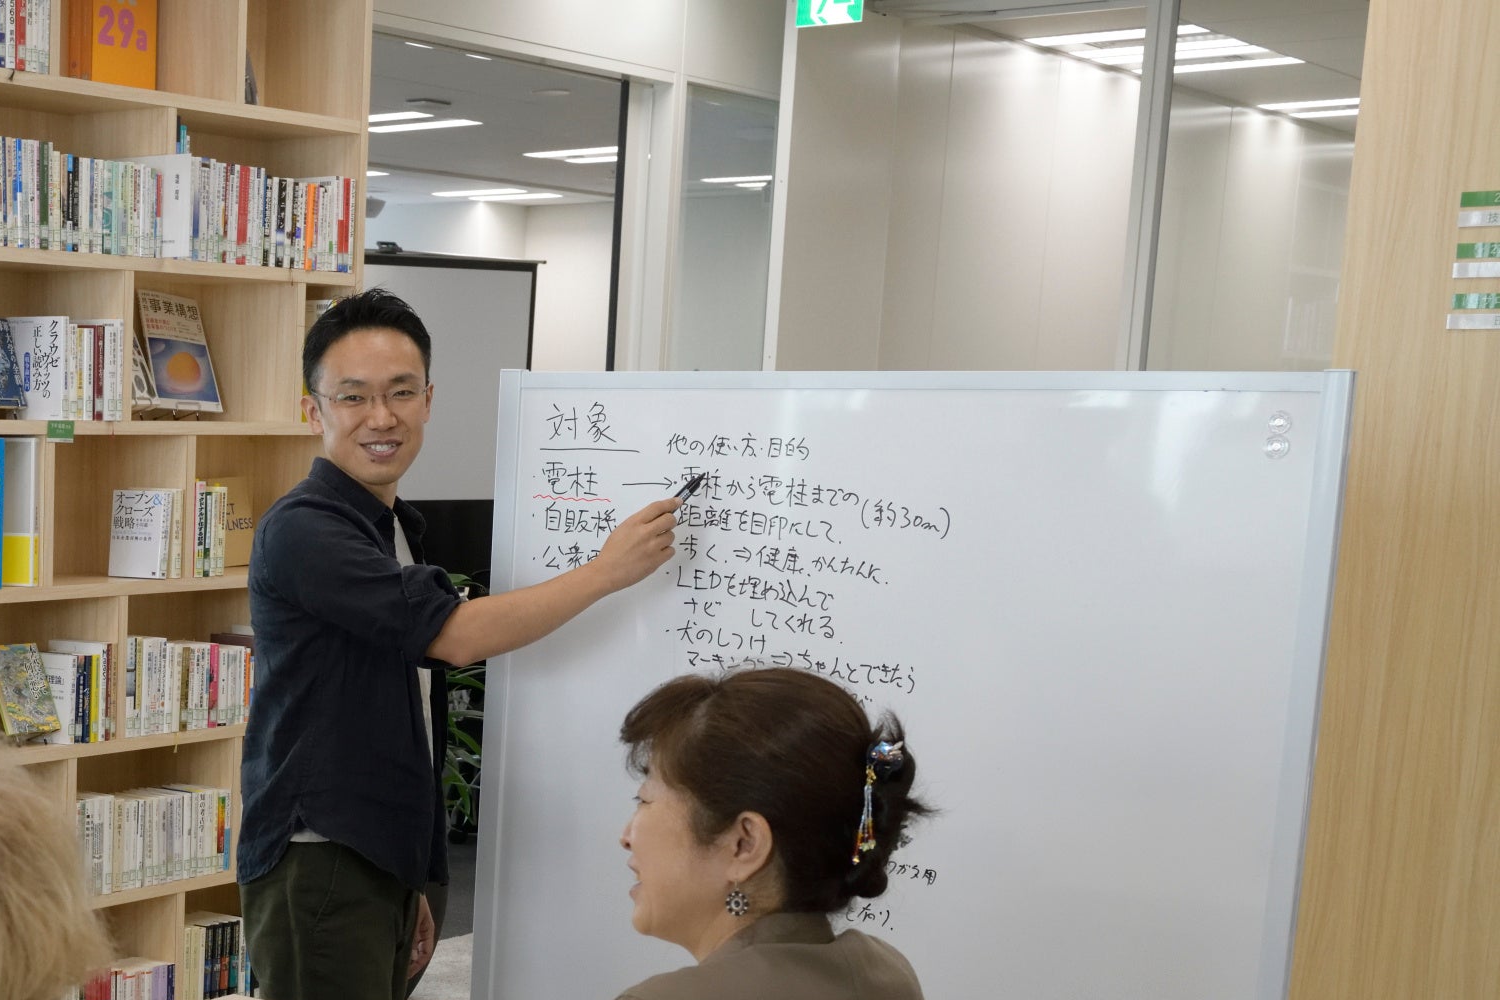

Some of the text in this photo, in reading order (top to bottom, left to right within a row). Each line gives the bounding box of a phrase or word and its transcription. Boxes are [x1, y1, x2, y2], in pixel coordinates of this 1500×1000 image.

[97, 5, 148, 52] 29a
[149, 298, 200, 321] 事業構想
[49, 319, 60, 369] クラウゼ
[546, 401, 617, 443] 対象
[542, 461, 599, 497] 電柱
[113, 504, 156, 518] クローズ
[113, 517, 136, 530] 戦略
[542, 541, 602, 570] 公衆
